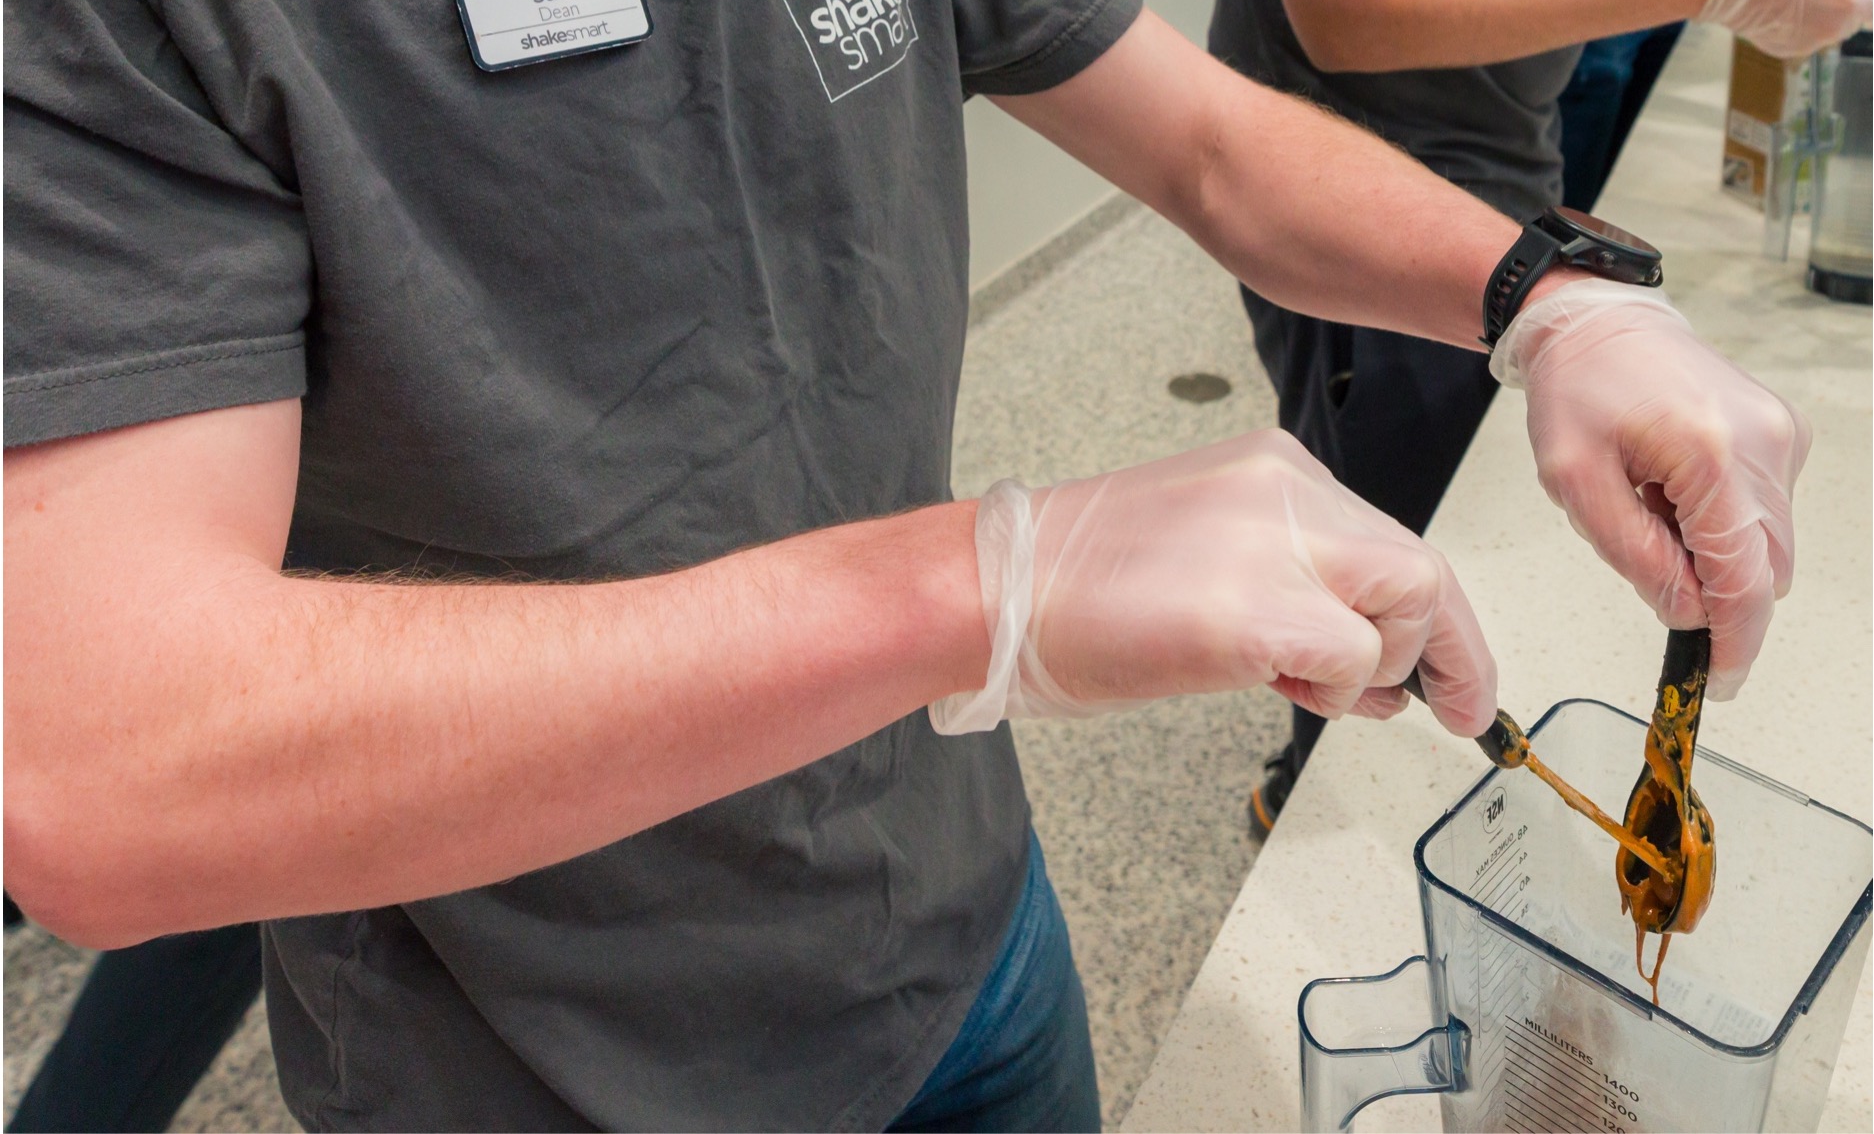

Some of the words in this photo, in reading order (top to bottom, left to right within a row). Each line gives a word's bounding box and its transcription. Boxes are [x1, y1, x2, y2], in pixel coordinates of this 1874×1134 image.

[538, 3, 580, 22] Dean
[520, 20, 611, 50] shakesmart
[839, 9, 908, 70] sma
[1524, 1017, 1594, 1065] MILLILITERS
[1603, 1073, 1639, 1102] 1400
[1603, 1094, 1638, 1122] 1300
